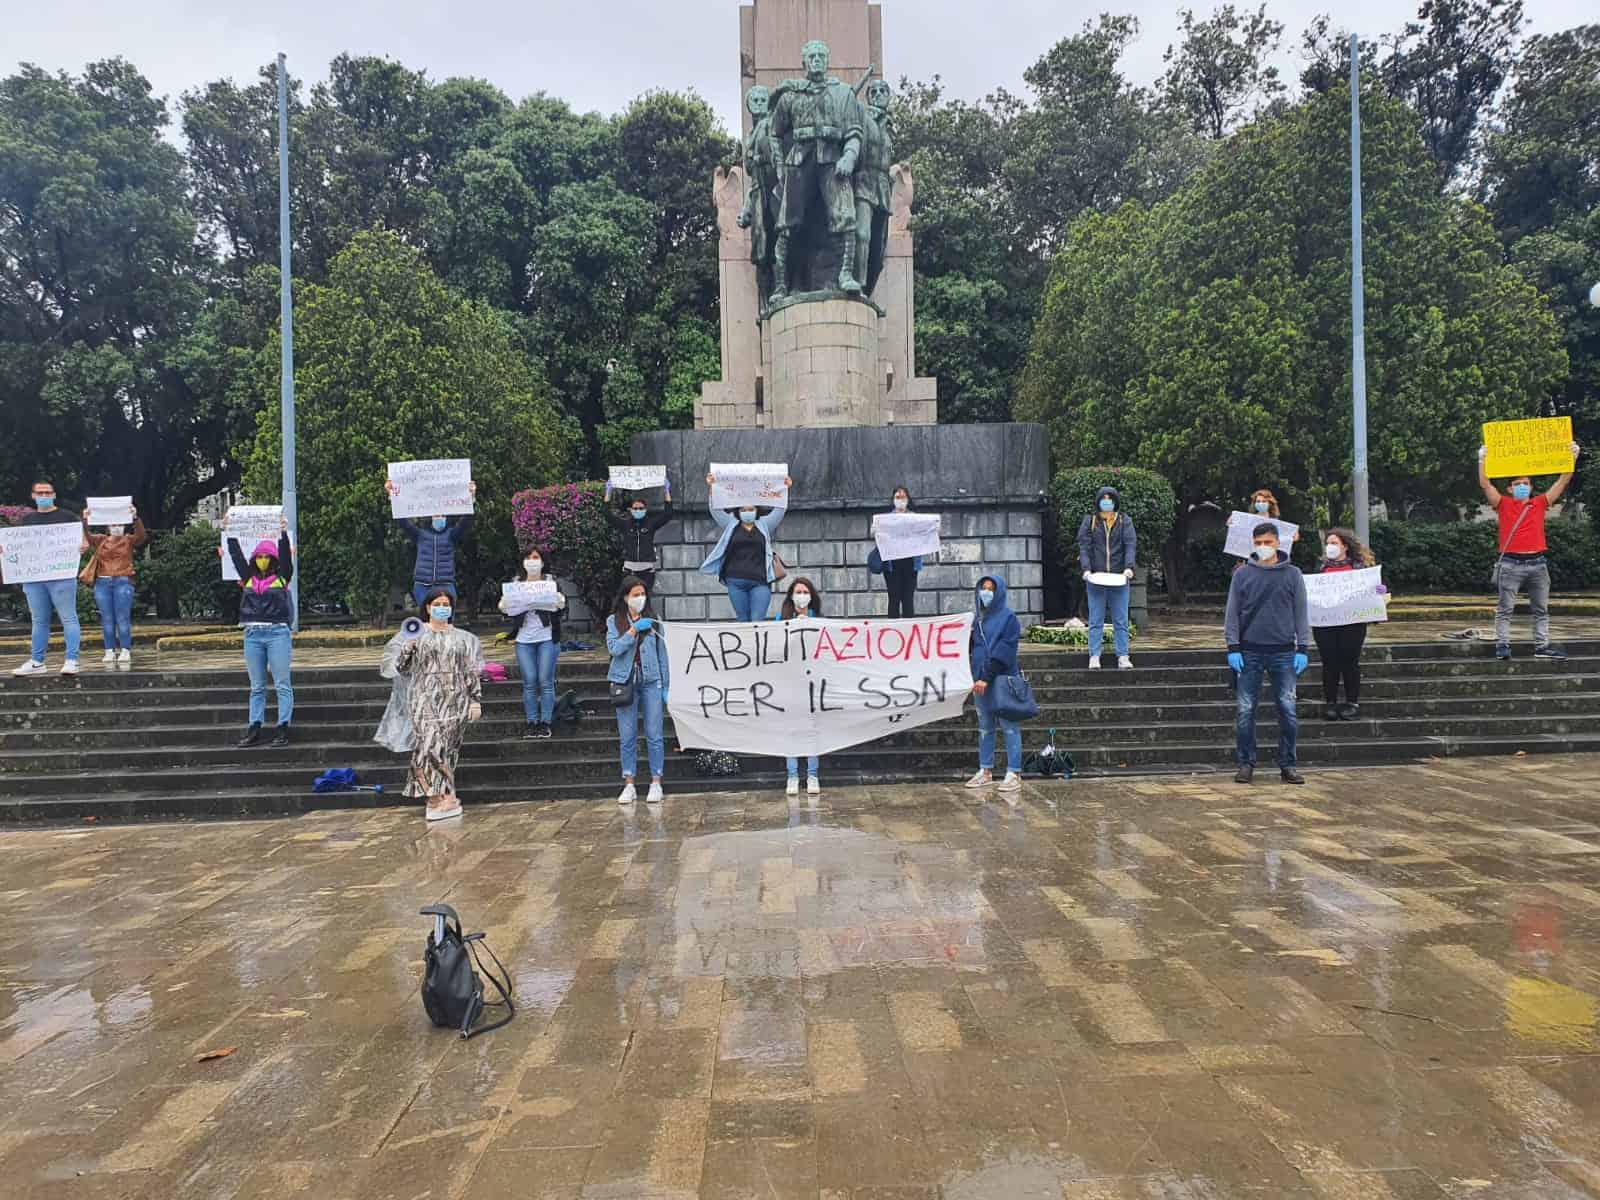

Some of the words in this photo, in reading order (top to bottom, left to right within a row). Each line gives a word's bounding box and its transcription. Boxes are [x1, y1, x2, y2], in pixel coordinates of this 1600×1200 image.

[686, 621, 965, 675] ABILITAZIONE
[697, 681, 785, 718] PER
[808, 670, 844, 714] IL
[858, 671, 947, 709] SSN
